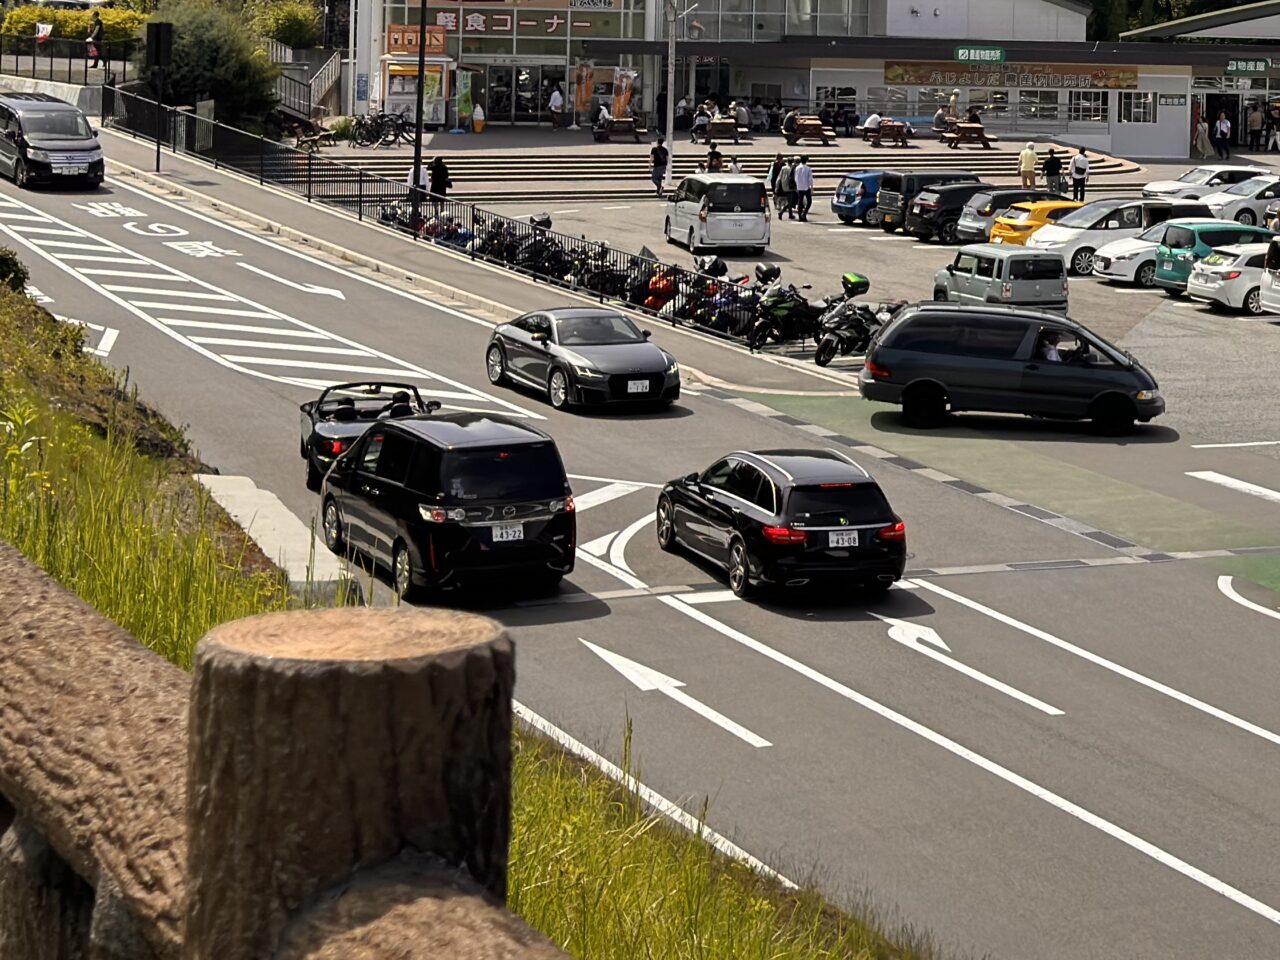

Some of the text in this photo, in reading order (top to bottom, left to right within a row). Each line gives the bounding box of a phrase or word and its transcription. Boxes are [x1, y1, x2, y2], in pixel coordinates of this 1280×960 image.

[436, 11, 592, 33] 軽食コーナー
[929, 72, 1092, 87] ふじよしだ 農産物直売所
[499, 529, 522, 540] 43-22
[836, 536, 857, 545] 43-08
